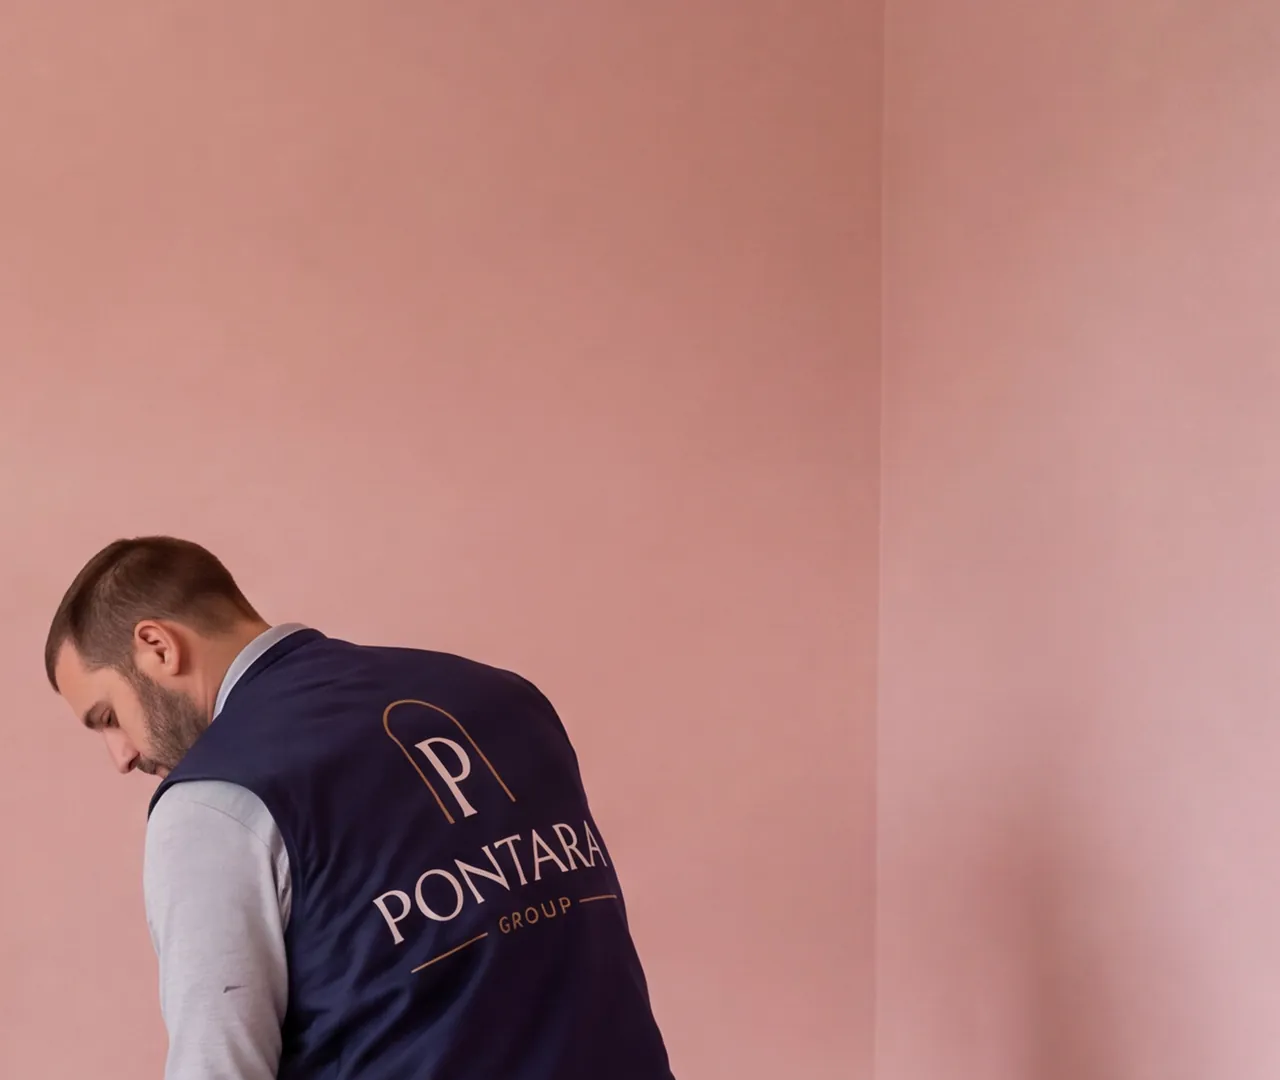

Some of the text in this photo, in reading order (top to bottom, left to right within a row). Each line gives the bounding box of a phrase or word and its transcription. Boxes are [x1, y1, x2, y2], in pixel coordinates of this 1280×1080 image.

[414, 736, 478, 818] P
[372, 820, 608, 945] PONTARA
[498, 896, 572, 934] GROUP
